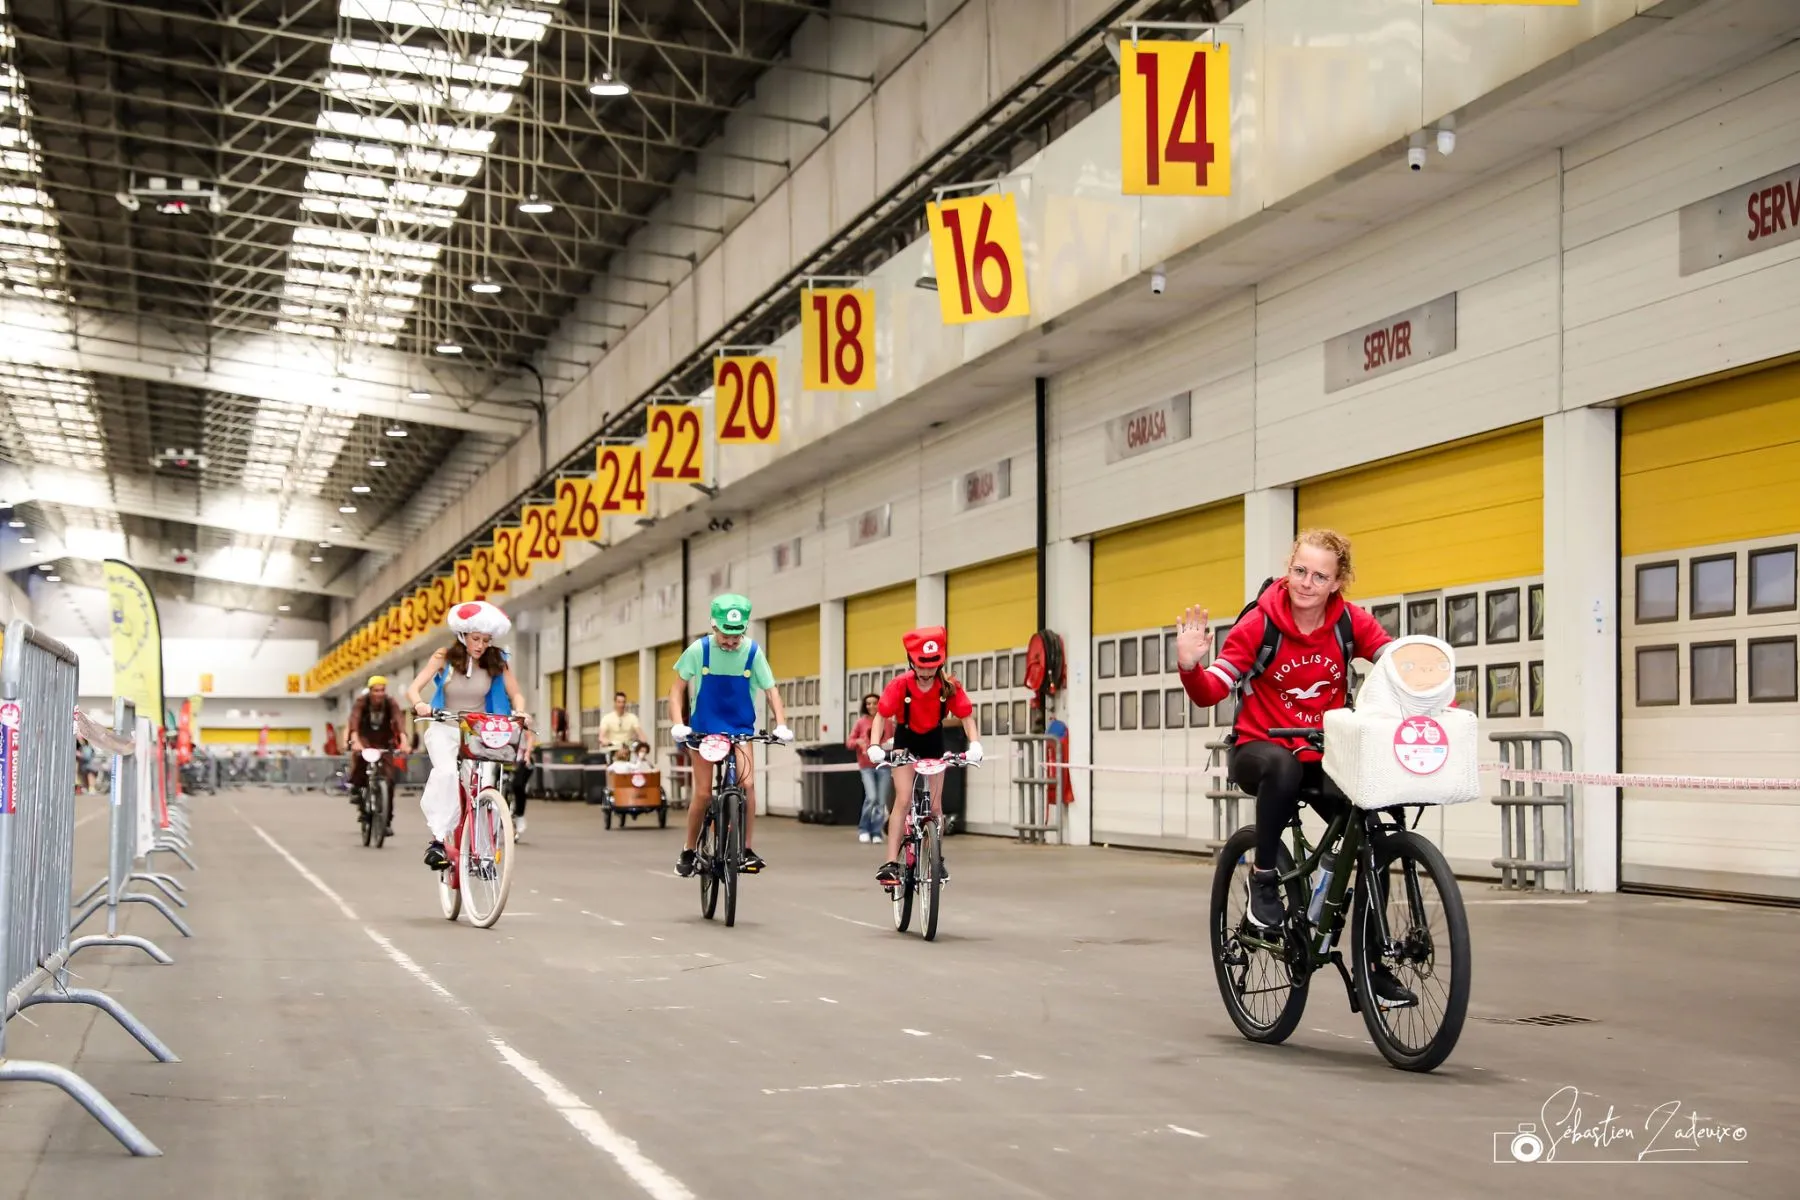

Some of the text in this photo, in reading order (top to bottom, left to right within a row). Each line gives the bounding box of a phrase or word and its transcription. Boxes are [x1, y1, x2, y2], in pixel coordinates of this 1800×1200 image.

[1136, 51, 1215, 186] 14
[941, 202, 1012, 315] 16
[813, 294, 864, 385] 18
[1364, 321, 1411, 371] SERVER
[718, 361, 776, 440] 20
[1128, 409, 1166, 448] GARASA
[651, 410, 700, 478] 22
[559, 482, 599, 537] 26
[600, 450, 645, 511] 24
[527, 509, 560, 559] 28
[1273, 654, 1341, 681] HOLLISTER
[1278, 689, 1293, 709] OS
